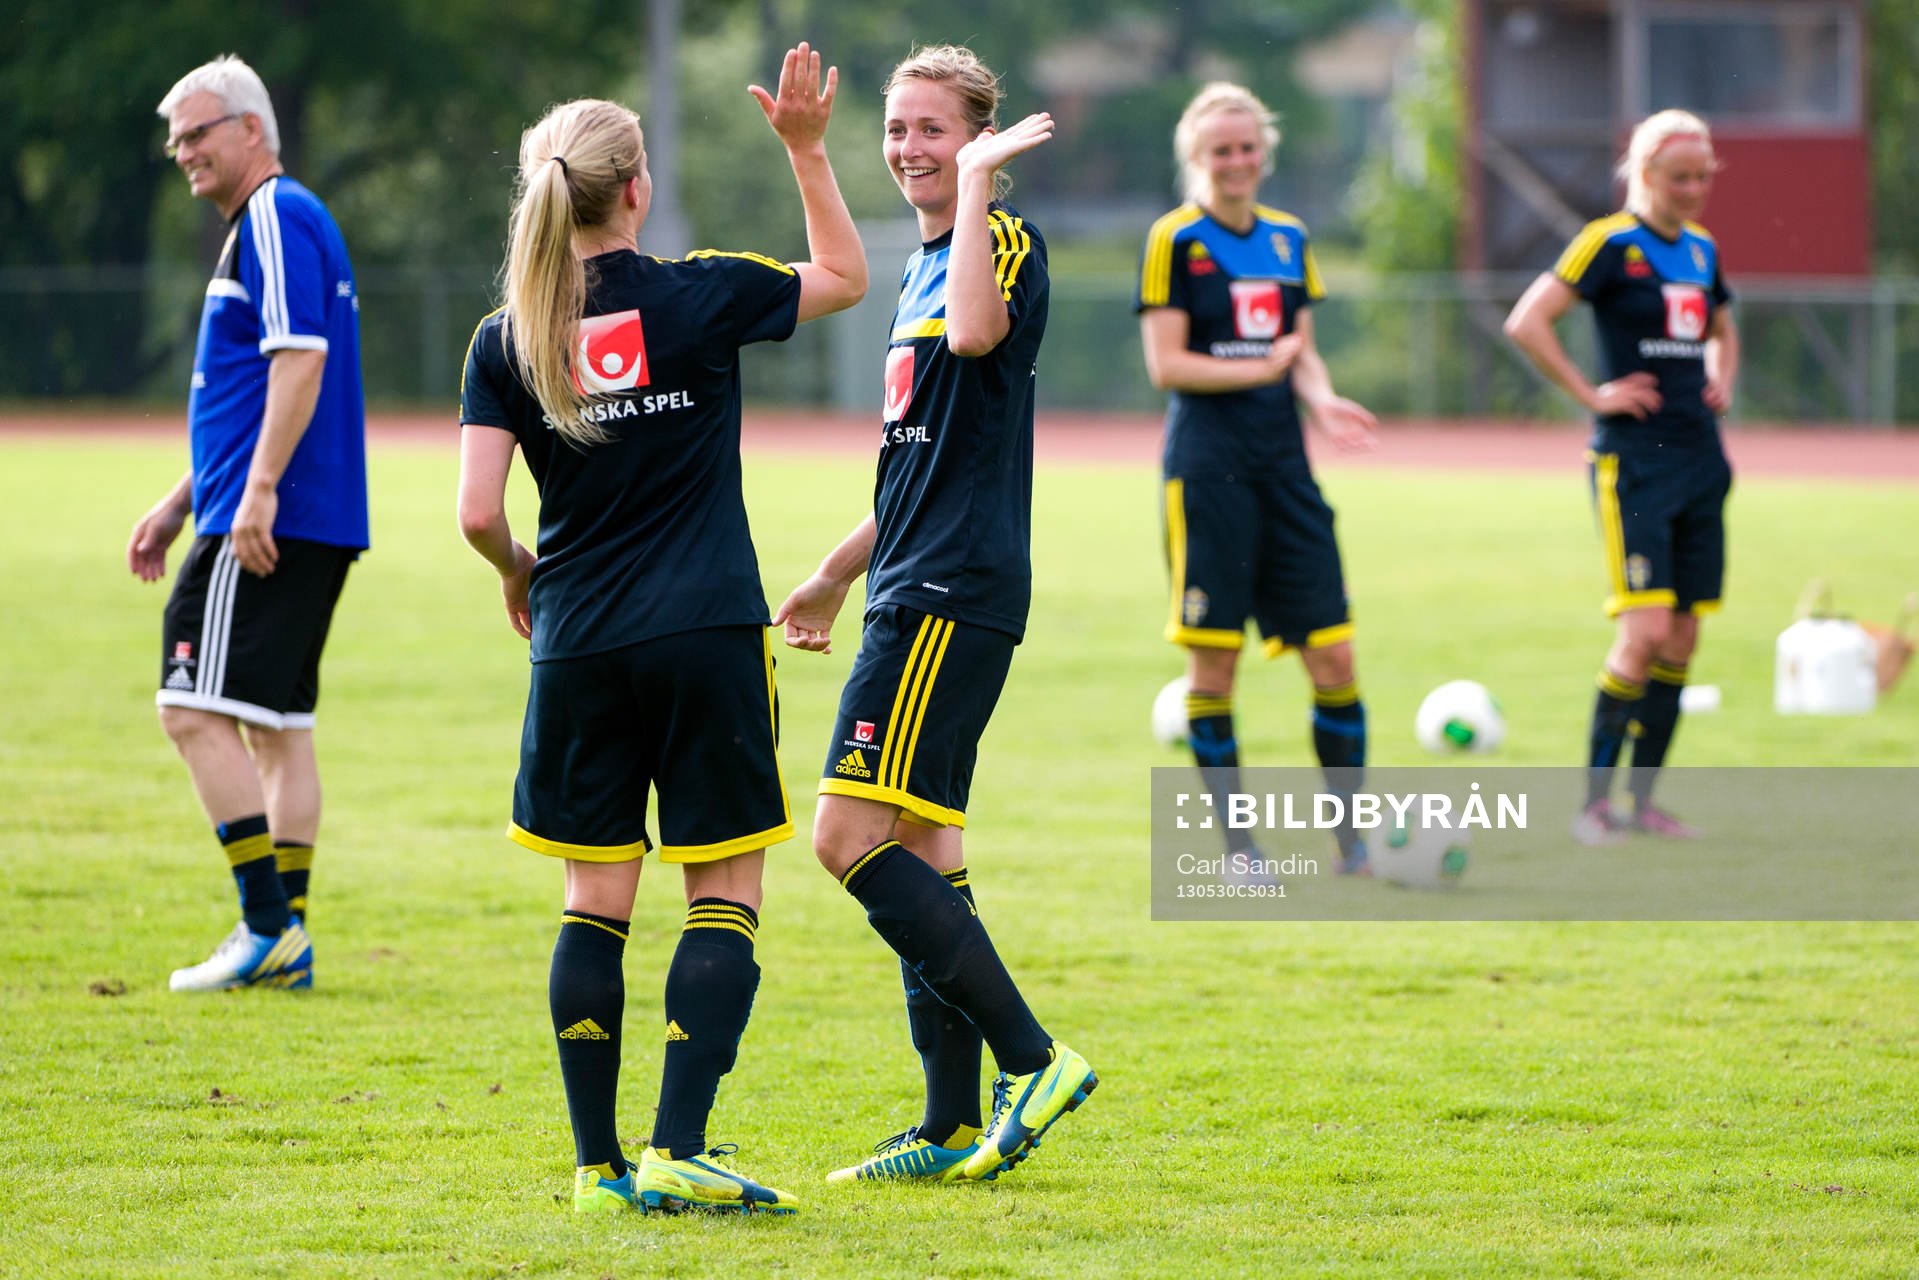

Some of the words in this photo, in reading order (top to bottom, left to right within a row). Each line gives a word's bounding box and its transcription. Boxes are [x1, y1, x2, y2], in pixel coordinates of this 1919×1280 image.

[542, 400, 638, 430] SNSKA
[643, 390, 694, 414] SPEL
[894, 425, 931, 443] SPEL
[835, 764, 871, 778] adidas
[559, 1031, 610, 1041] adidas
